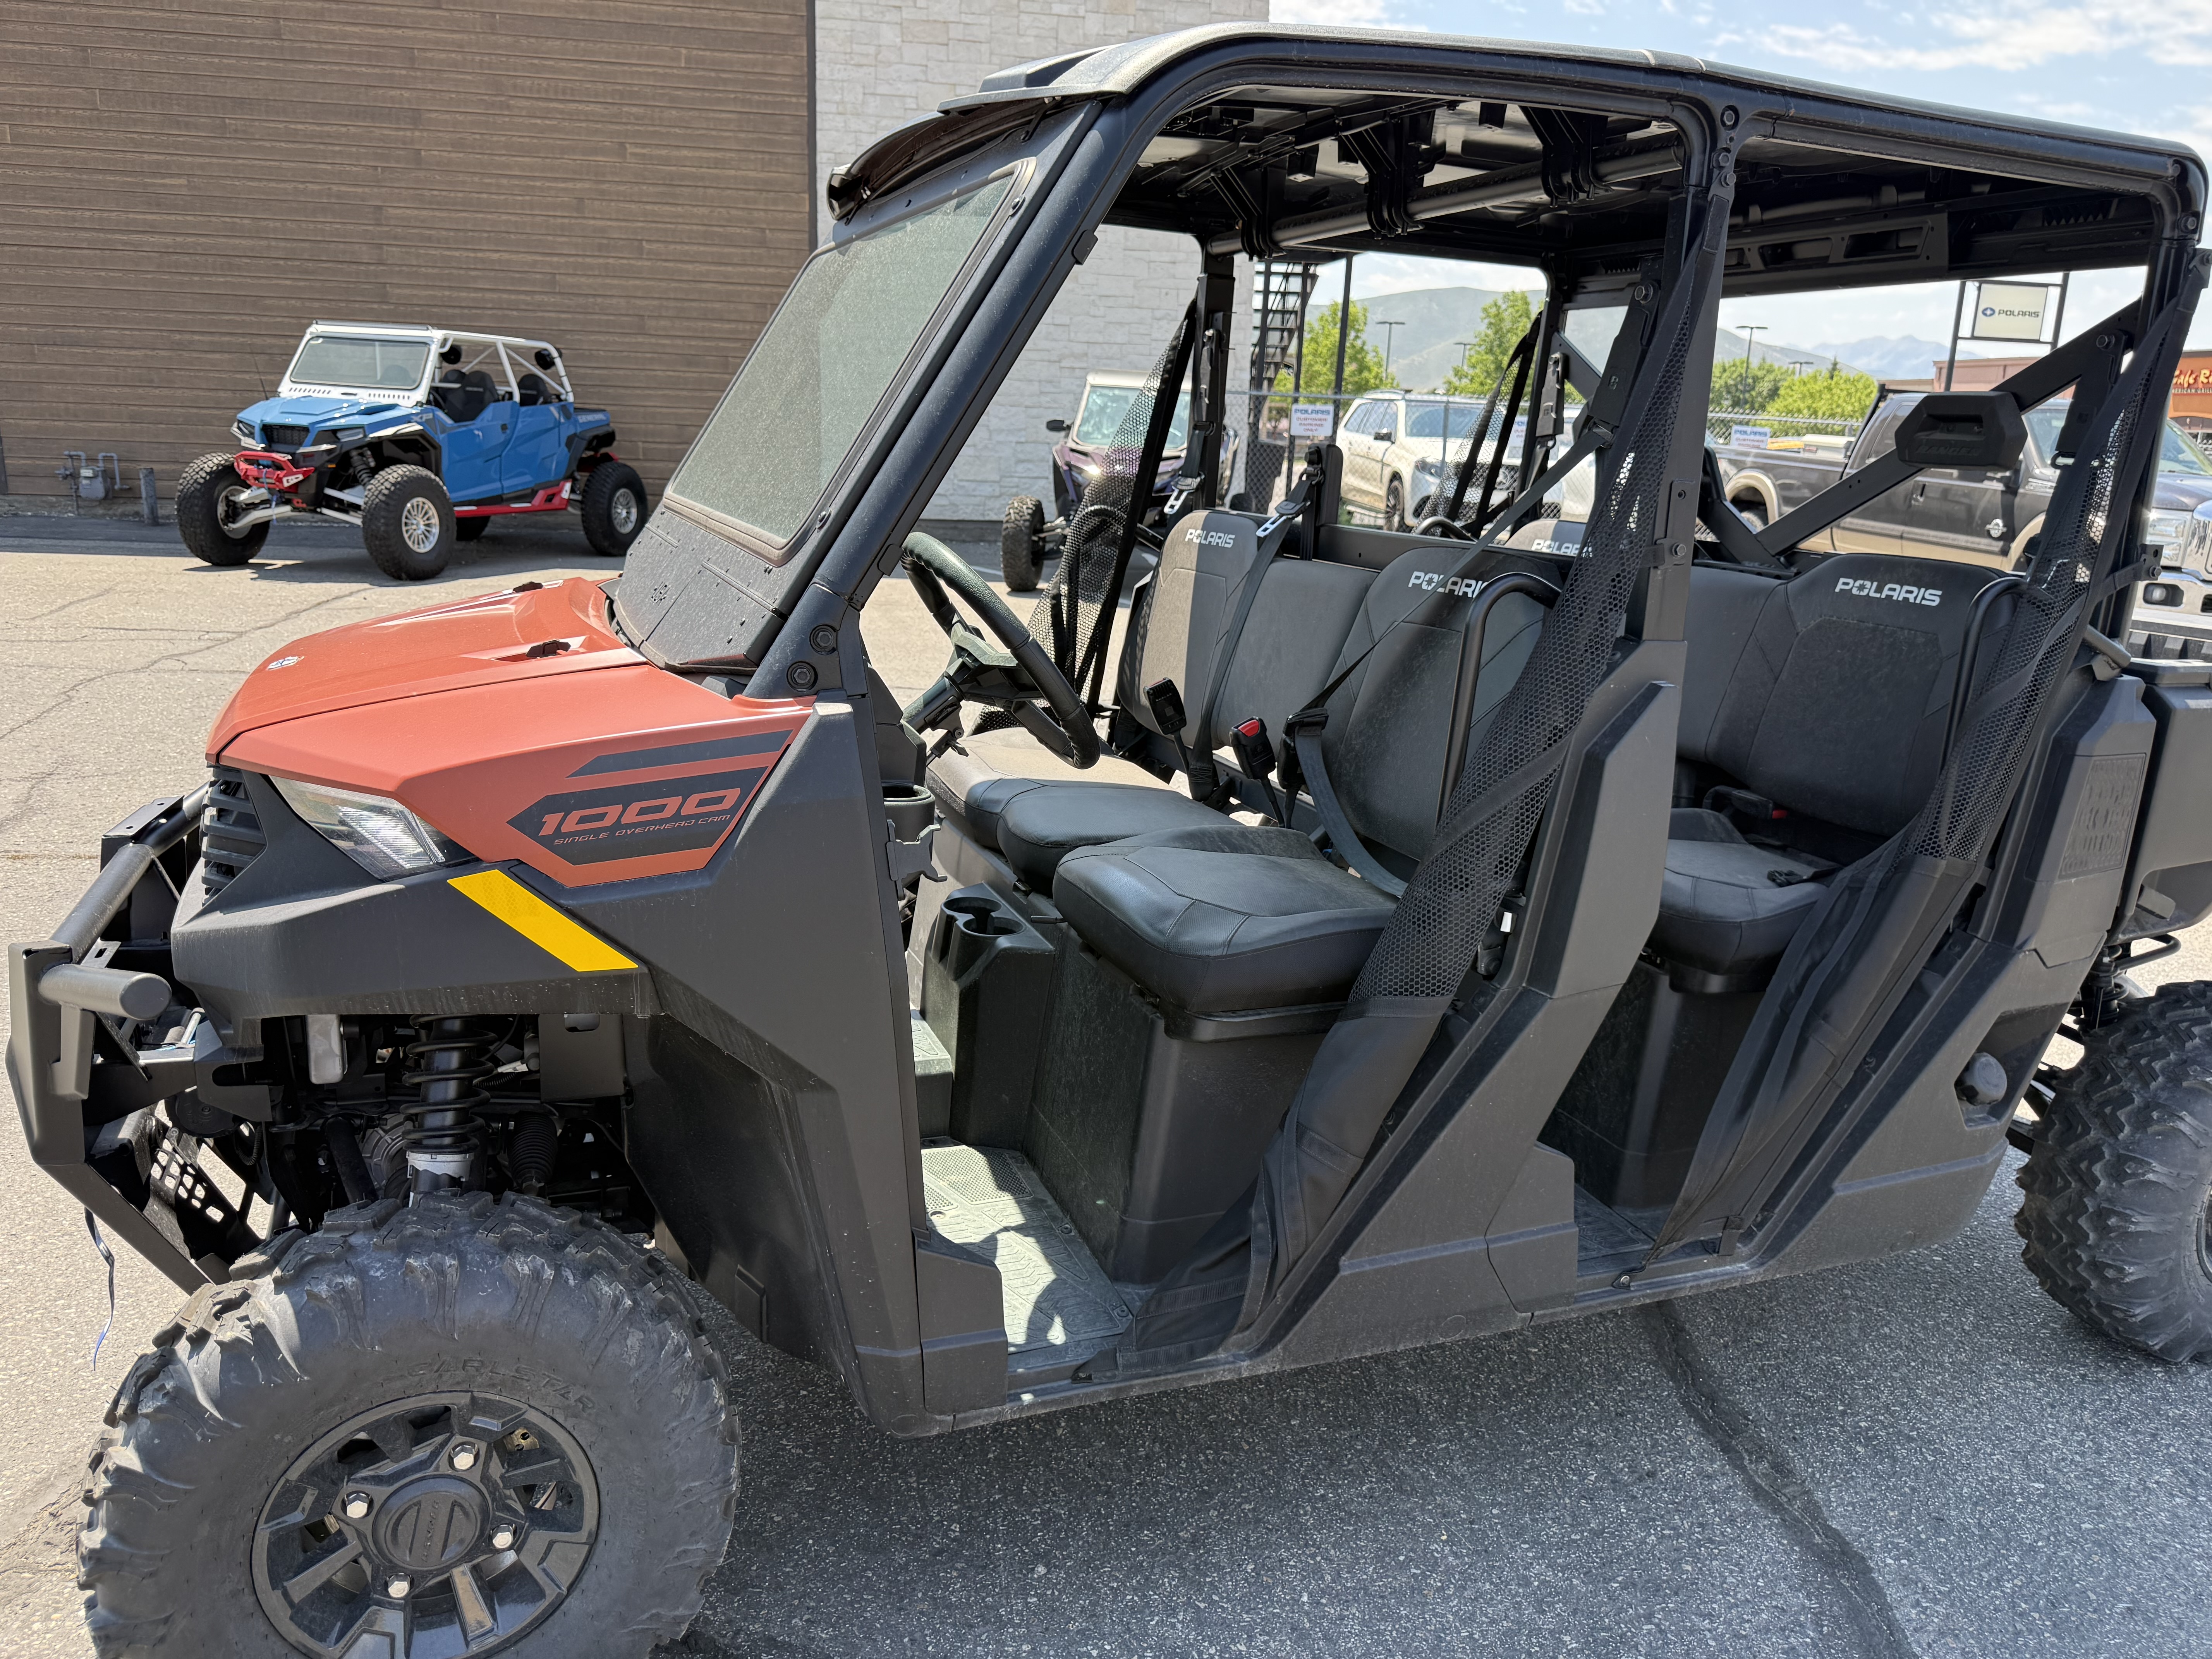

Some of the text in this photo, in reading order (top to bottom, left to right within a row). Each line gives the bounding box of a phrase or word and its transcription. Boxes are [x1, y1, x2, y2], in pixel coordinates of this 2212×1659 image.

[1997, 309, 2040, 318] POLARIS
[1185, 529, 1235, 548] POLARIS
[1835, 578, 1942, 606] POLARIS
[539, 788, 740, 836] 1000
[553, 814, 730, 845] SINGLE OVERHEAD CAM
